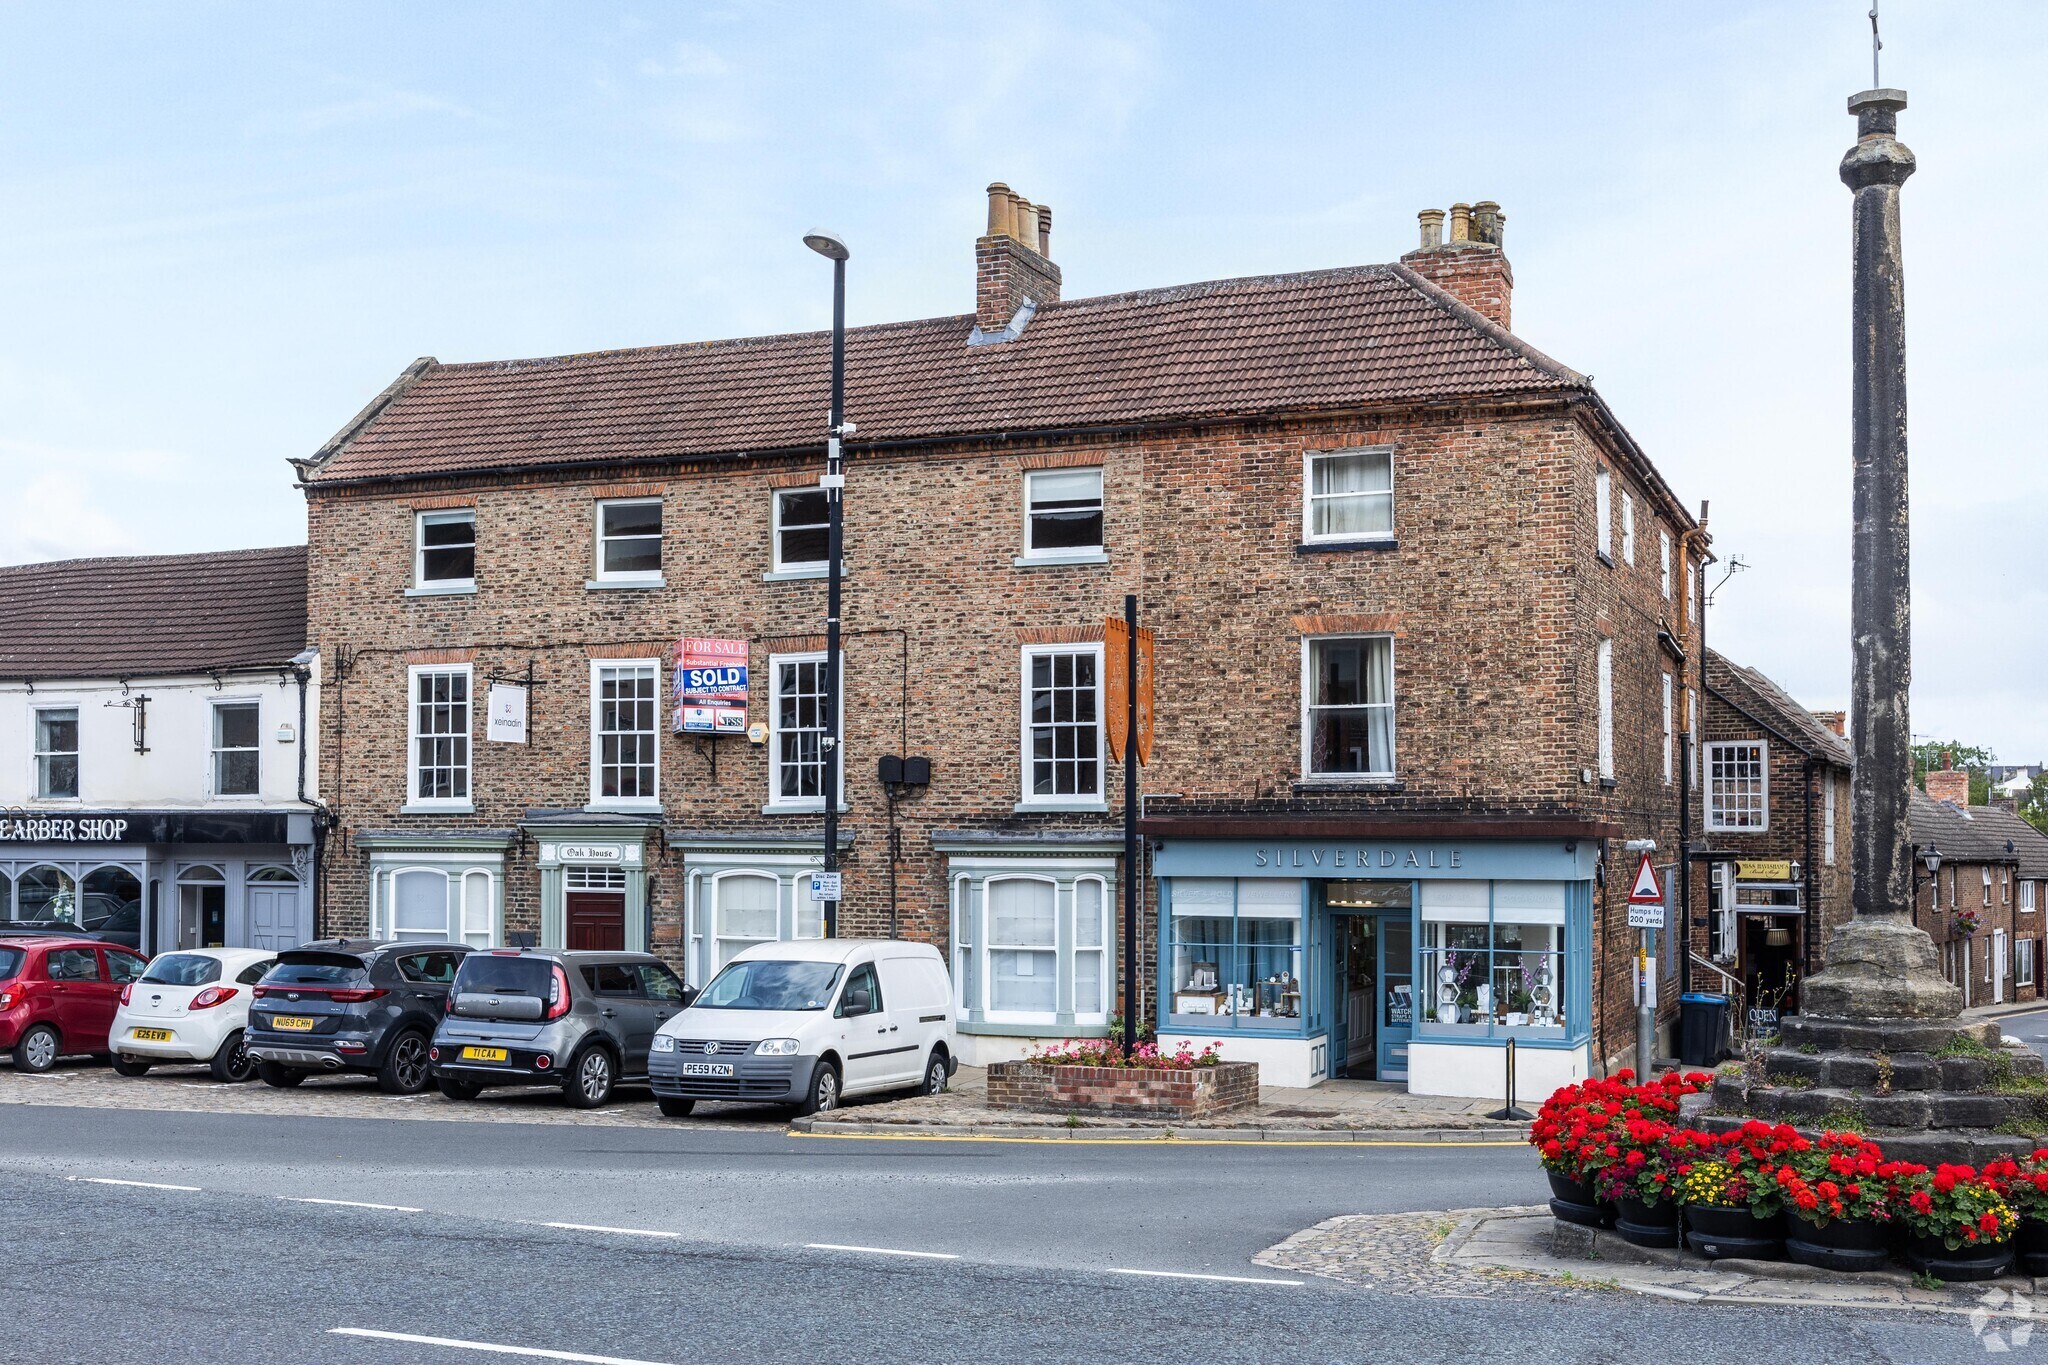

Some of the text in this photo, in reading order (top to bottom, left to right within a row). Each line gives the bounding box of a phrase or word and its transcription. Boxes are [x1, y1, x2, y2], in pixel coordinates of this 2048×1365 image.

[686, 641, 745, 655] FOR SALE
[686, 659, 718, 667] Substantial
[690, 668, 740, 686] SOLD
[685, 686, 709, 694] SUBJECT
[494, 717, 522, 728] xeinadin
[726, 717, 743, 727] FSS
[78, 819, 128, 841] SHOP
[567, 848, 613, 857] Oak House
[1256, 849, 1462, 868] SILVERDALE
[1630, 907, 1651, 915] Humps
[1630, 915, 1662, 925] 200 yards
[1749, 1008, 1777, 1022] OPEN
[276, 1018, 311, 1028] NU69 CHH
[137, 1030, 166, 1040] E25 EVB
[481, 1049, 497, 1058] CAA
[687, 1064, 730, 1075] PE59 KZN
